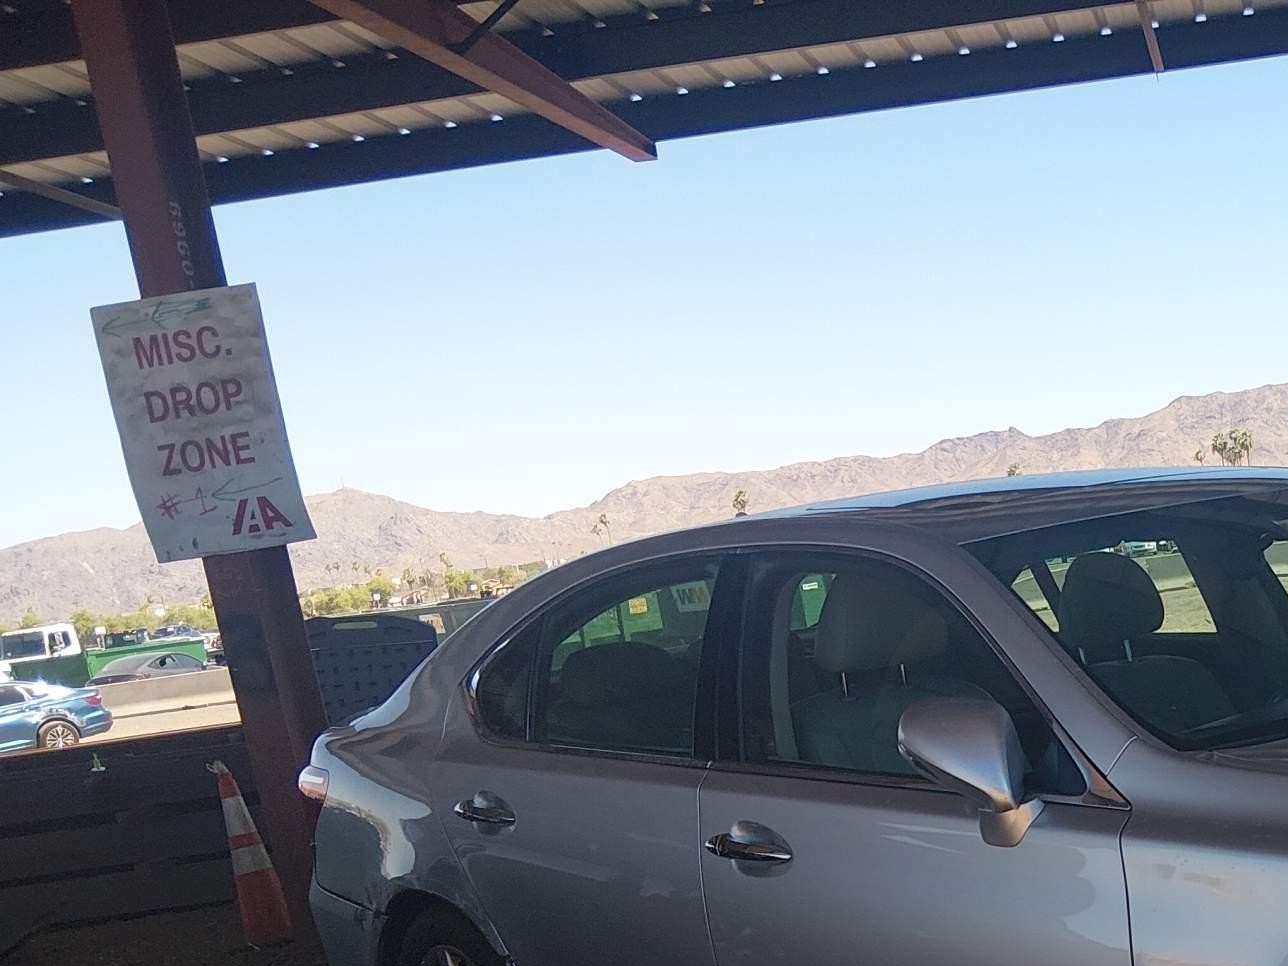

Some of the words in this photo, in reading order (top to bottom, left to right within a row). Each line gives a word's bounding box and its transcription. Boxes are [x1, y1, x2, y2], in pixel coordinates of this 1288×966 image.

[132, 325, 233, 370] MISC.
[144, 378, 243, 424] DROP
[157, 431, 256, 477] ZONE
